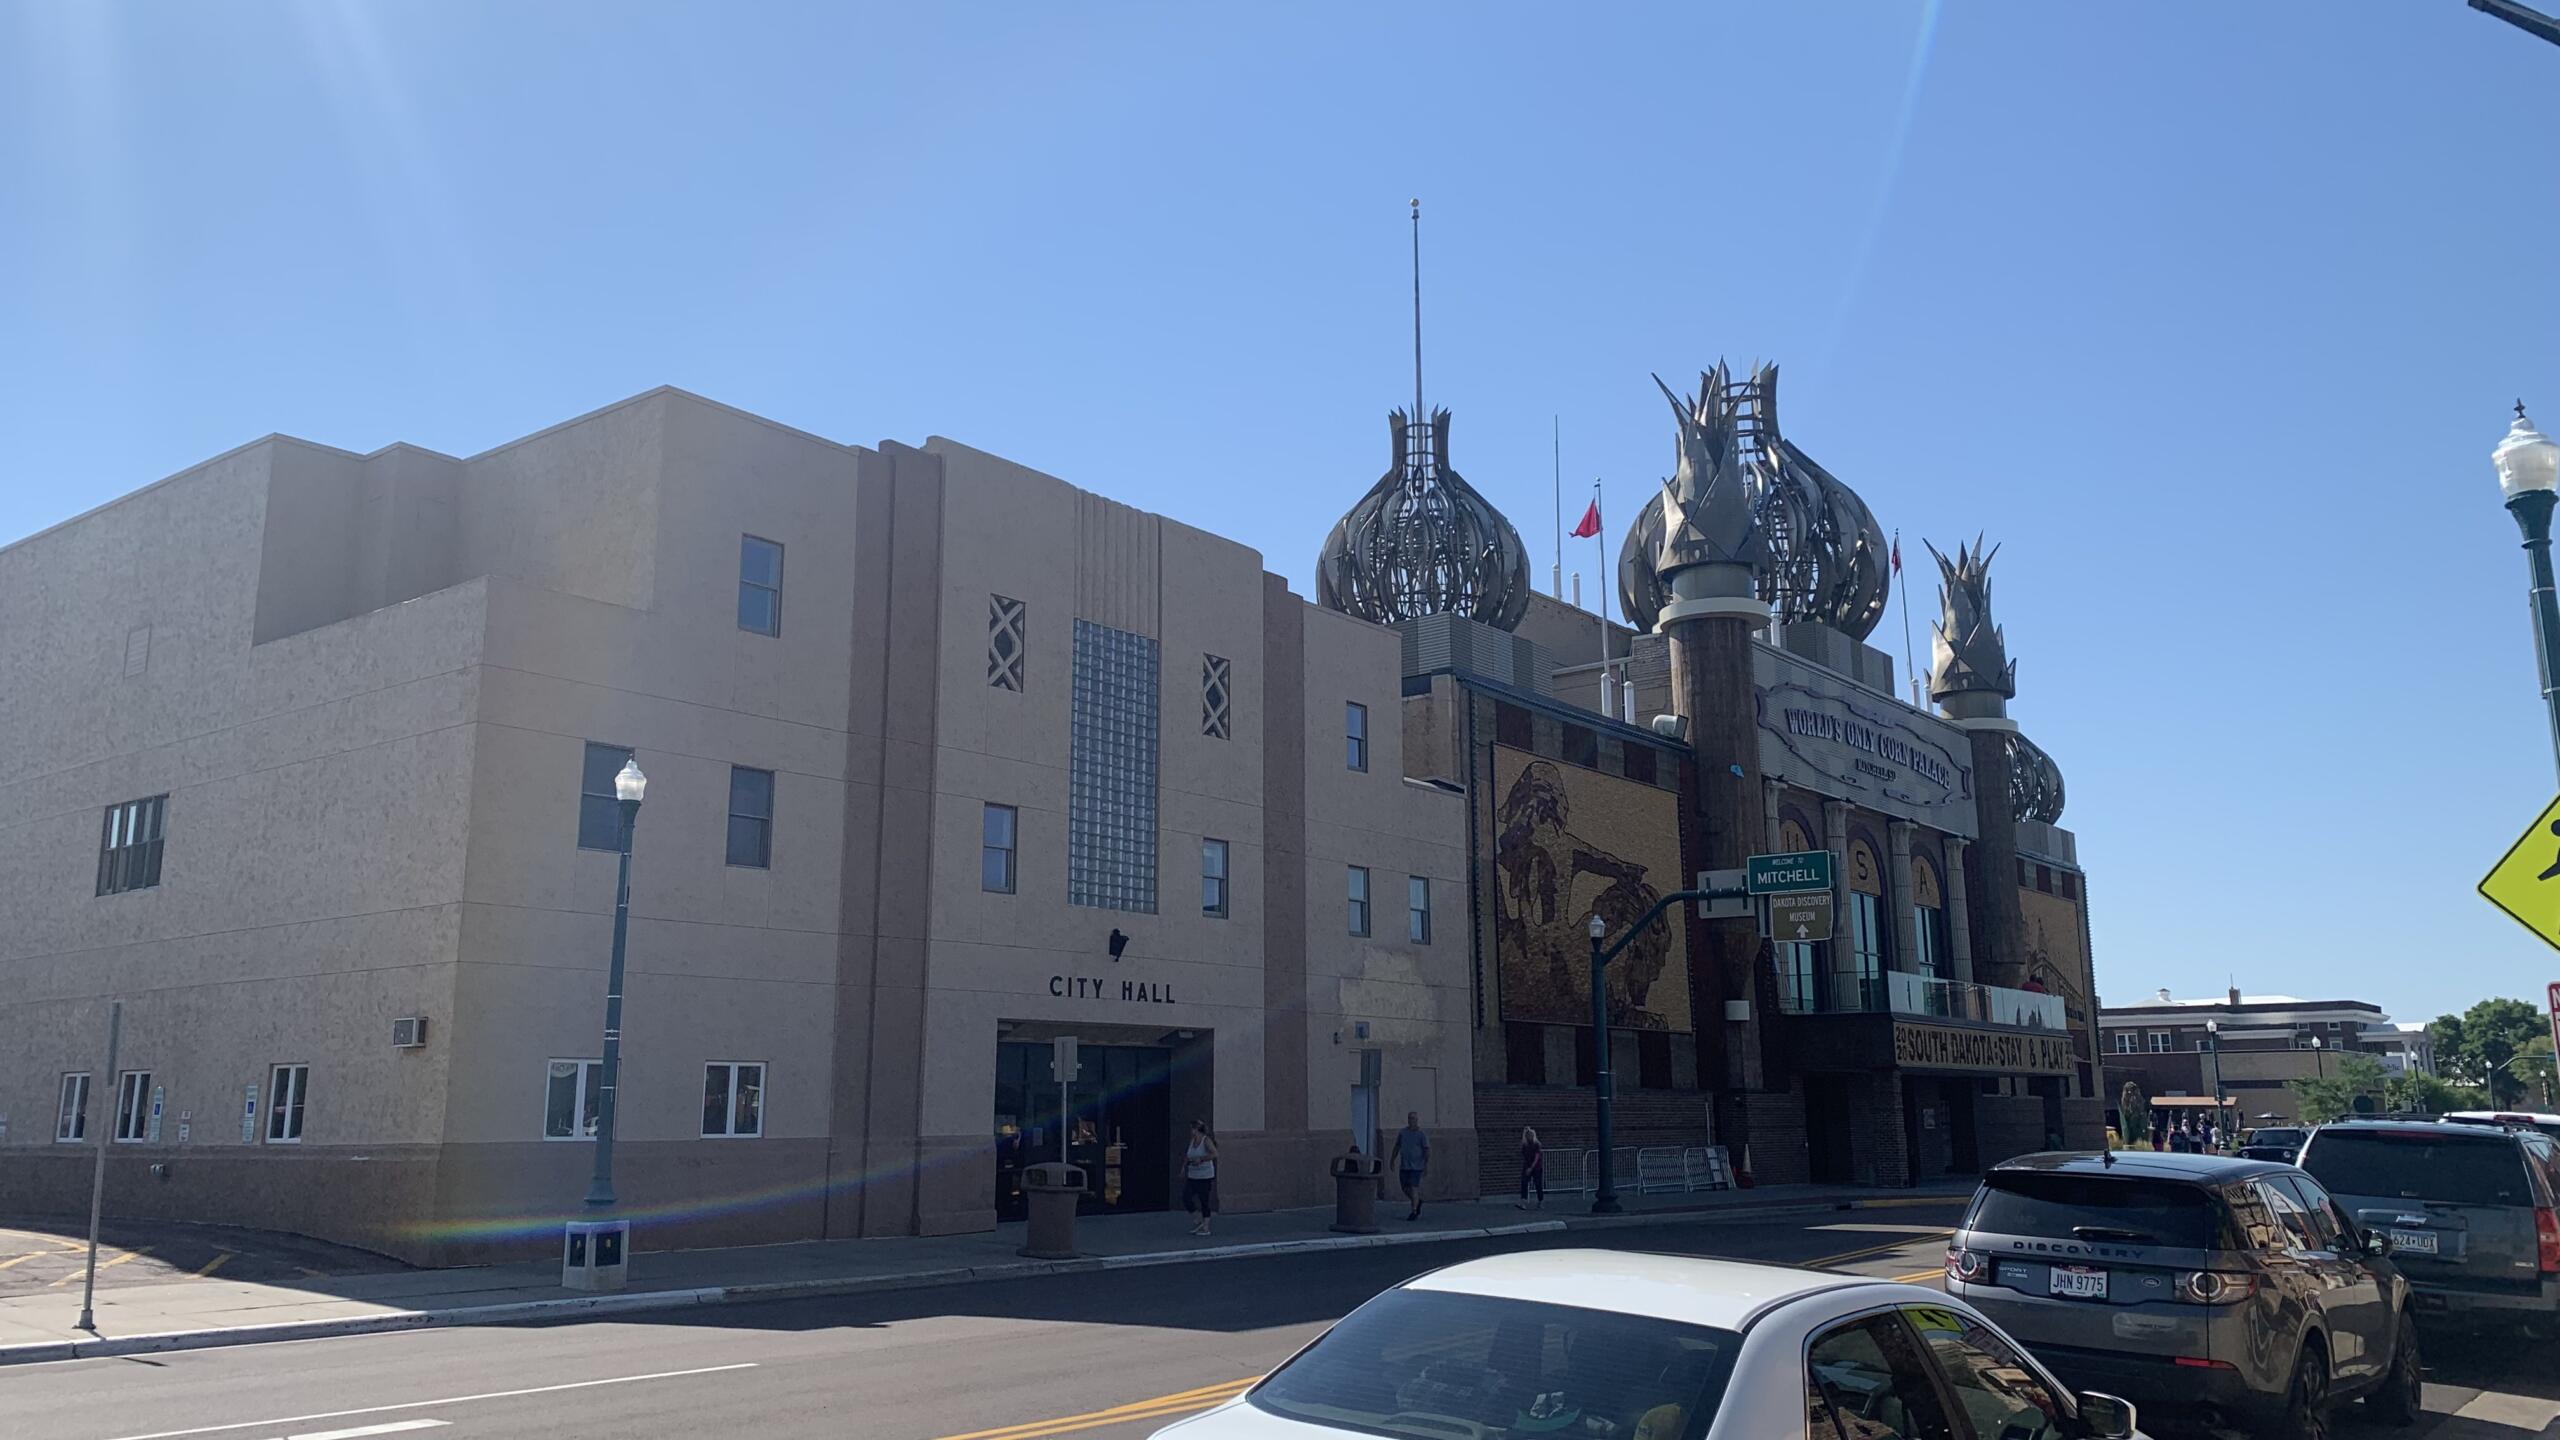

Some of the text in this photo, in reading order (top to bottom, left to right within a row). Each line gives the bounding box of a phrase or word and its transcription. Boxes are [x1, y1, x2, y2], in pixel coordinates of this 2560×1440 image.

[1785, 708, 1951, 790] WORLD'S ONLY CORN PALACE
[1757, 868, 1820, 885] MITCHELL
[1856, 850, 1868, 880] S
[1920, 864, 1930, 895] A
[1773, 895, 1831, 908] DAKOTA DISCOVERY
[1789, 911, 1816, 921] MUSEUM
[1049, 975, 1175, 1004] CITY HALL
[1908, 1028, 1948, 1063] SOUTH
[1999, 1036, 2022, 1067] STAY
[2041, 1039, 2064, 1069] PLAY
[2013, 1241, 2143, 1259] DISCOVERY
[2053, 1274, 2104, 1292] JHN 9775
